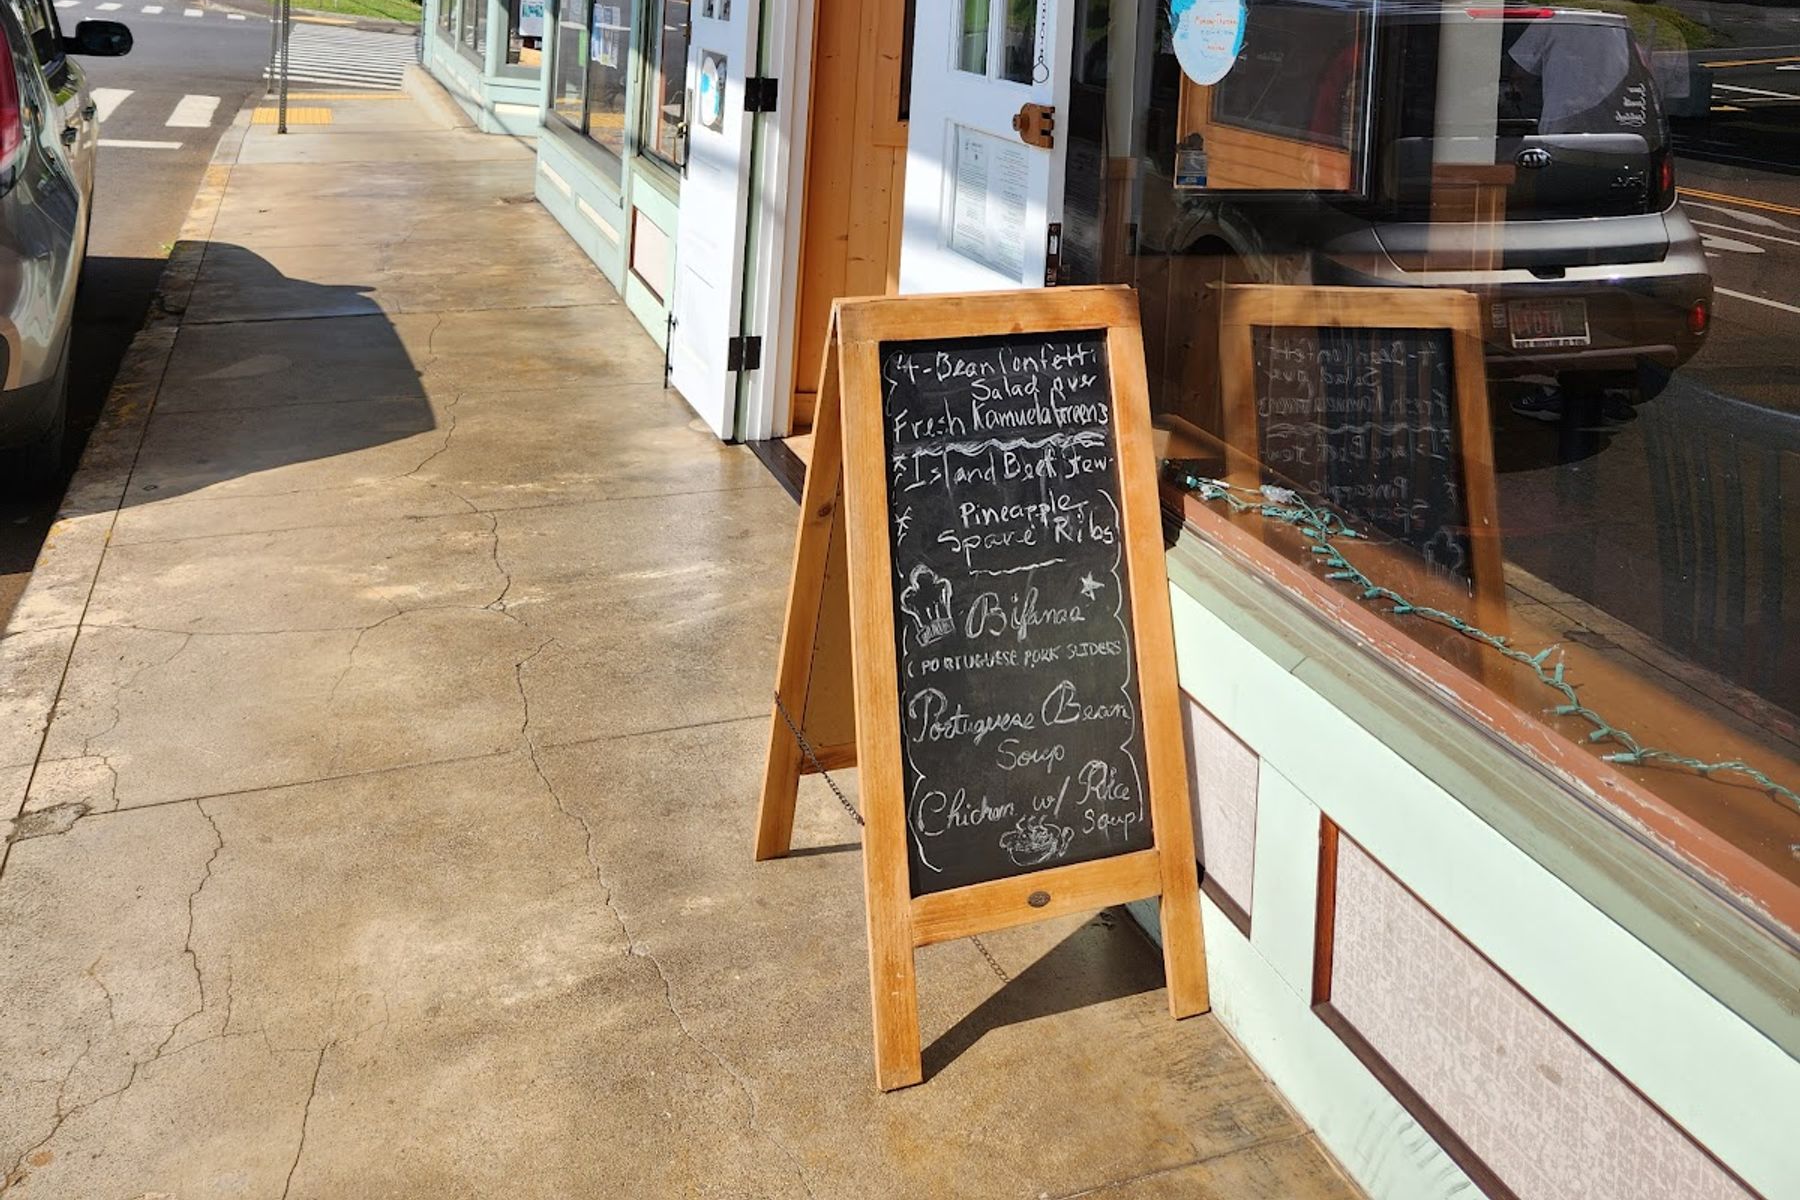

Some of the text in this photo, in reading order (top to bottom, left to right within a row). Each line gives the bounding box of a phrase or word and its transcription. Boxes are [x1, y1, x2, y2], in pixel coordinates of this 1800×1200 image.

[970, 374, 1040, 401] Salad
[893, 396, 967, 442] Fresh
[936, 510, 1115, 568] Spare Ribs
[1023, 644, 1060, 668] PORK
[1066, 639, 1123, 661] SLIDERS
[1041, 679, 1132, 727] Bean
[996, 738, 1065, 774] Soup
[1077, 759, 1131, 805] Rice
[1082, 808, 1138, 841] Soup
